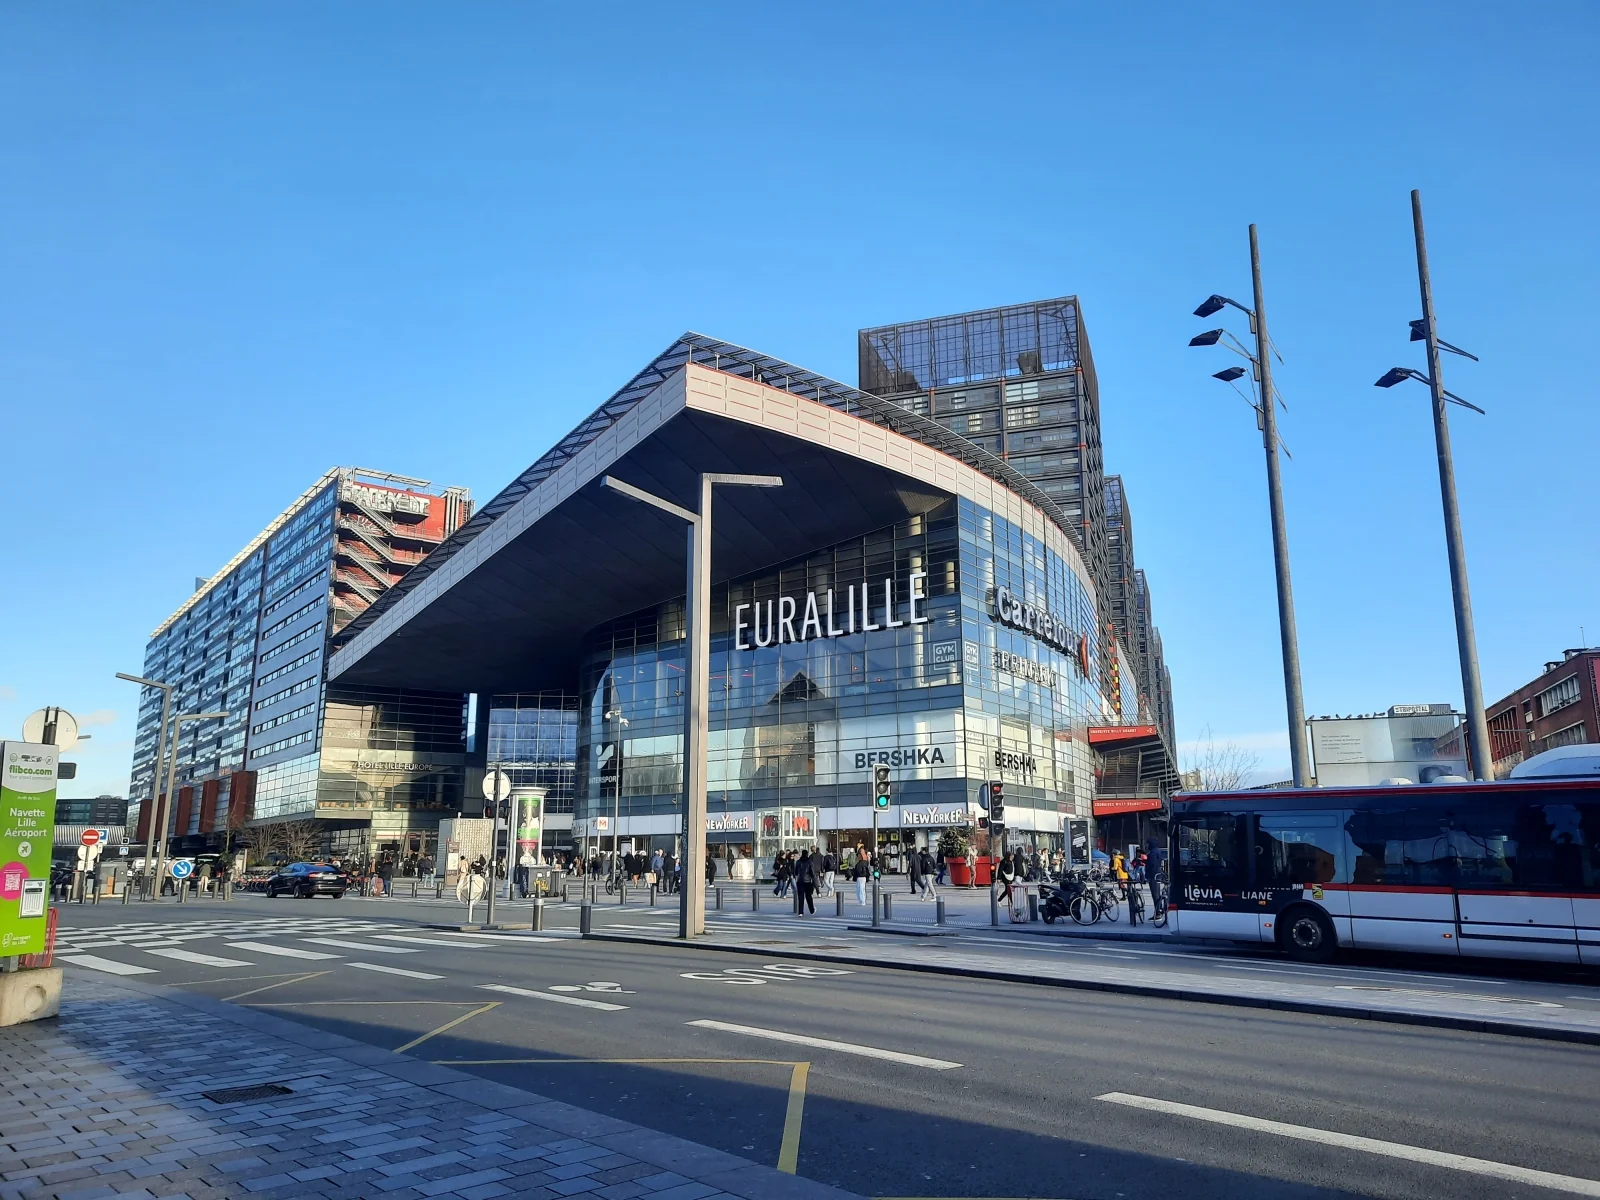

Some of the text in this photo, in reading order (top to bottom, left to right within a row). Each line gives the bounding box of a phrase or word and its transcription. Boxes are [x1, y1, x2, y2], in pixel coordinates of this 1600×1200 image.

[735, 571, 928, 650] EURALILLE
[996, 585, 1081, 653] Carrefour
[935, 654, 955, 663] CLUB
[855, 747, 945, 769] BERSHKA
[994, 751, 1037, 774] BERSHKA
[9, 764, 53, 776] flibco.com
[404, 763, 433, 771] EUROPE
[589, 775, 619, 784] INTERSPOR
[9, 808, 46, 817] Navette
[17, 817, 37, 827] Lille
[4, 827, 48, 839] Aéroport
[1241, 891, 1273, 900] LIANE
[680, 963, 857, 985] BUS
